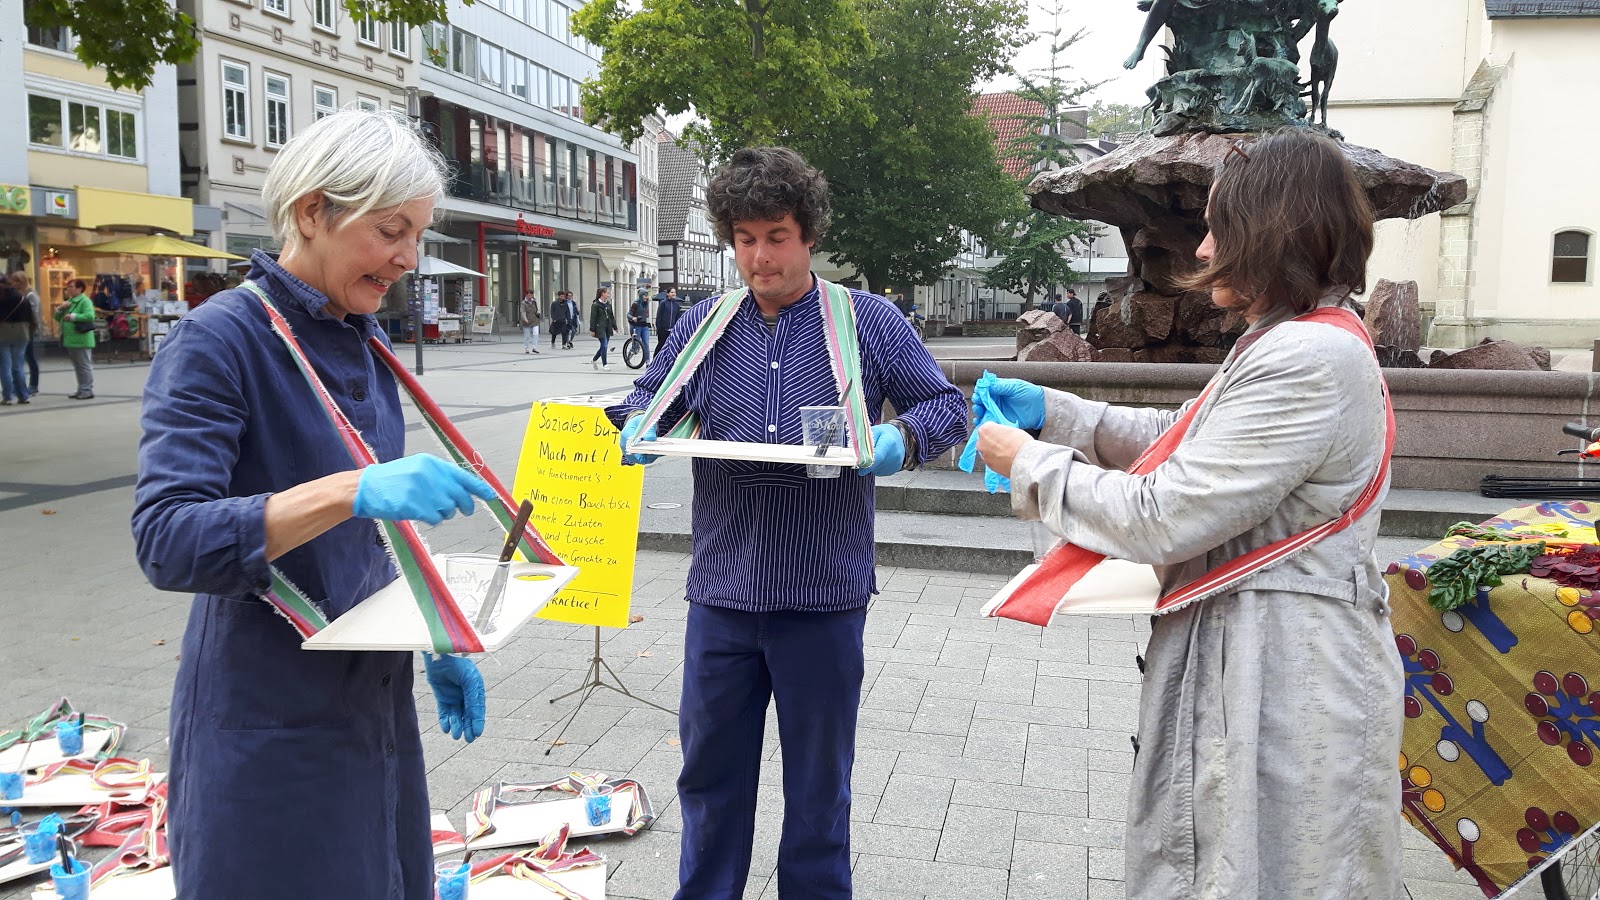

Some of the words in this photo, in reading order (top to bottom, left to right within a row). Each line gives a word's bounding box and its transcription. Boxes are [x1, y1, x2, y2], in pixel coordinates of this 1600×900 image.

[539, 407, 585, 434] Soziales
[539, 441, 567, 462] Mach
[551, 496, 573, 505] einen
[563, 514, 603, 529] Zutaten
[545, 530, 561, 542] und
[566, 530, 605, 546] tausche
[570, 549, 603, 566] Gerichte
